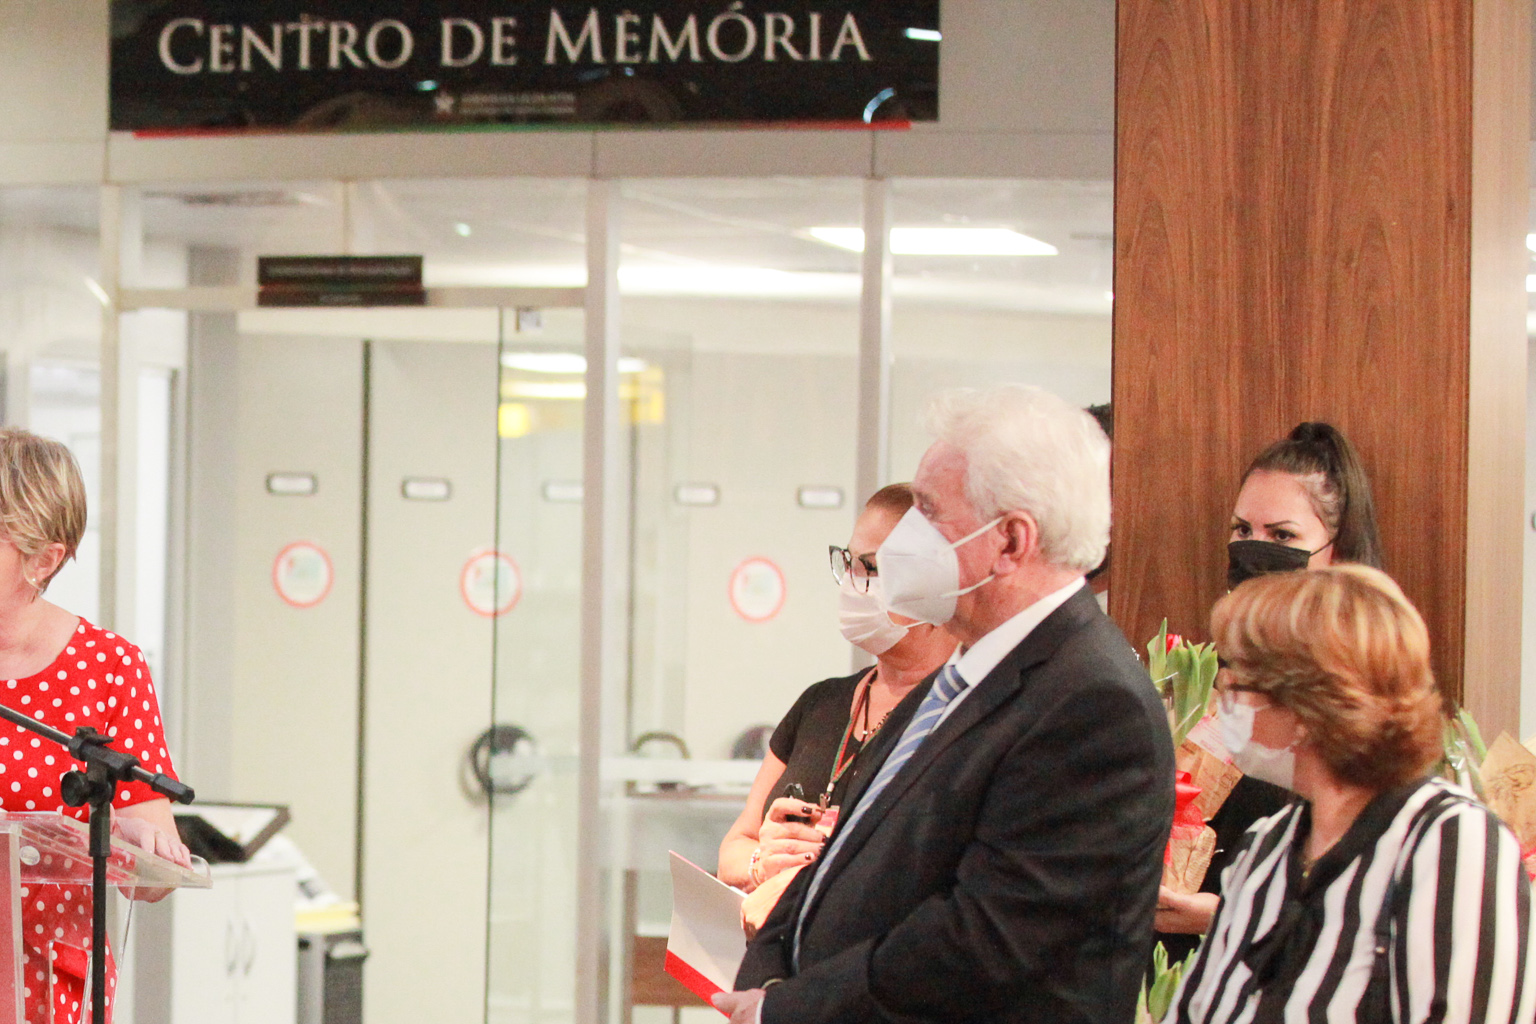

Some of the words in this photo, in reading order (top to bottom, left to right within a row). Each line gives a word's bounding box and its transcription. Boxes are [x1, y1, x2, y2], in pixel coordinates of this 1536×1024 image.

[159, 17, 414, 74] CENTRO
[440, 17, 518, 67] DE
[544, 1, 872, 64] MEMÓRIA
